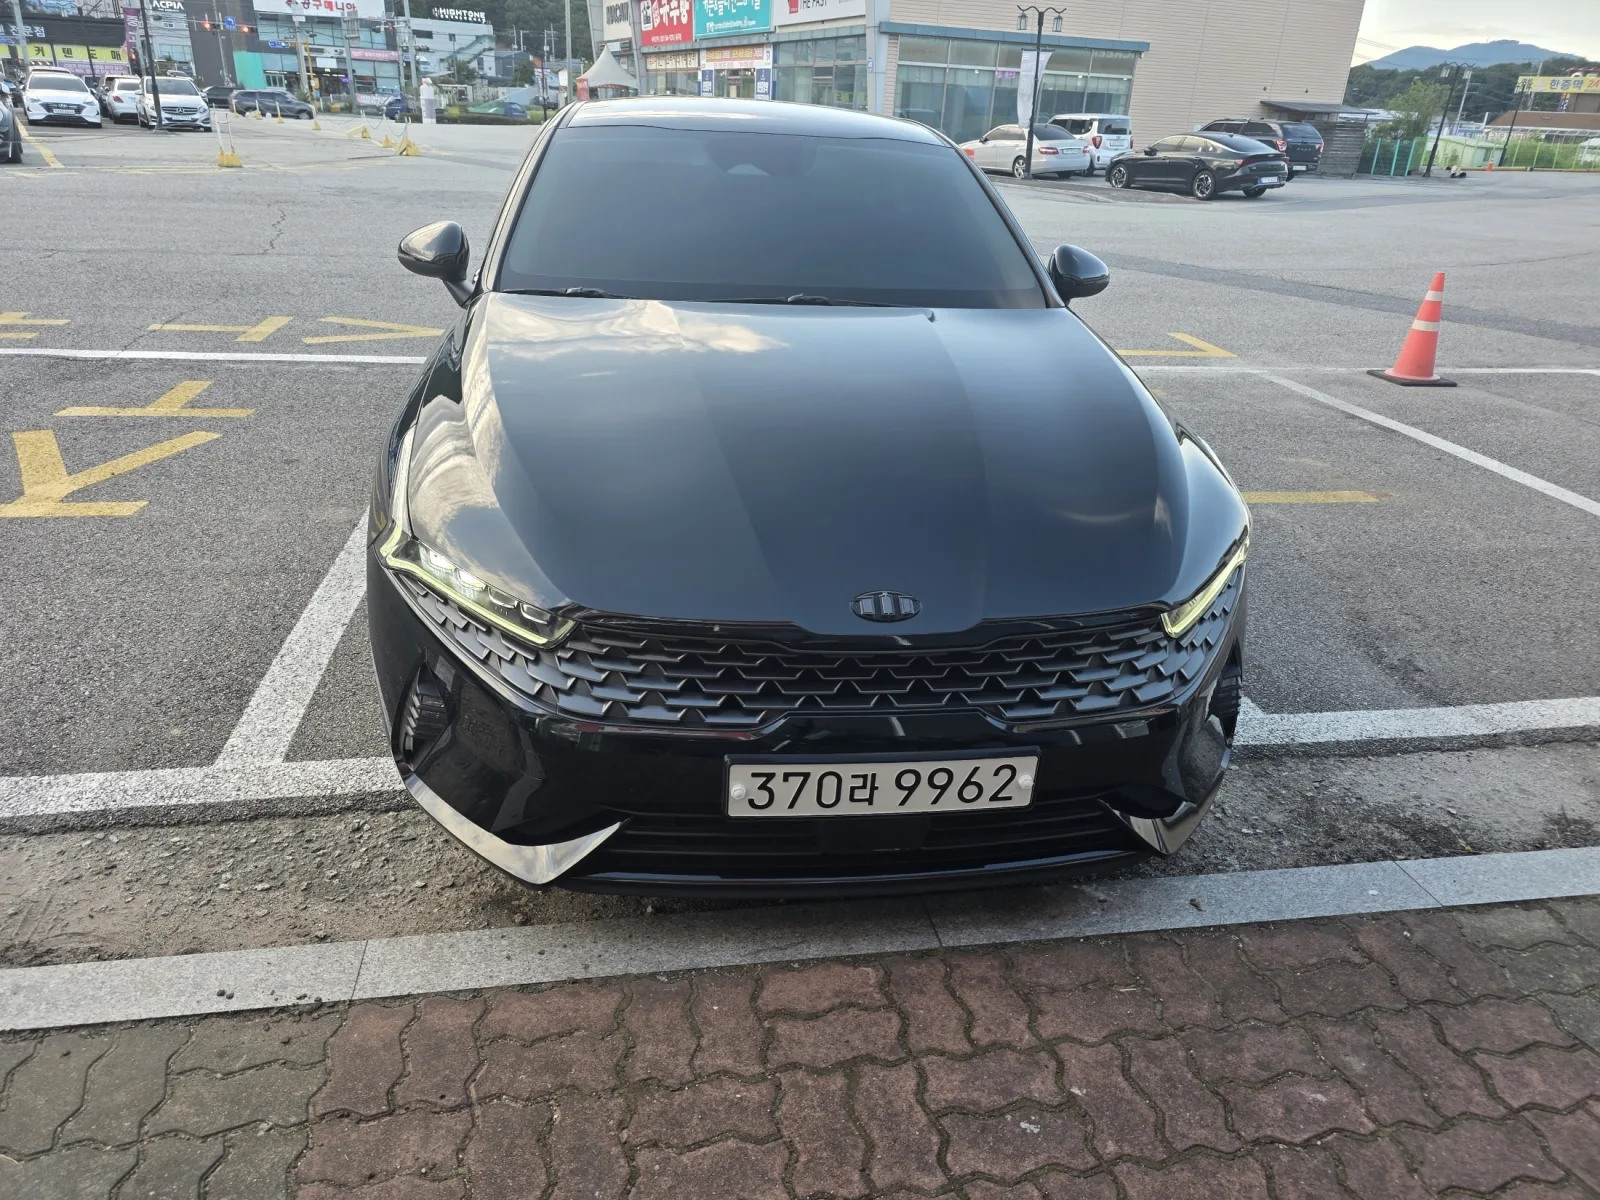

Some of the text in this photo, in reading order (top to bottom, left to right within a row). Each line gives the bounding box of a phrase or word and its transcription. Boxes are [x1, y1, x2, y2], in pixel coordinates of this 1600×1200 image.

[439, 7, 486, 19] HIGHTONE
[747, 763, 1018, 810] 370라 9962
